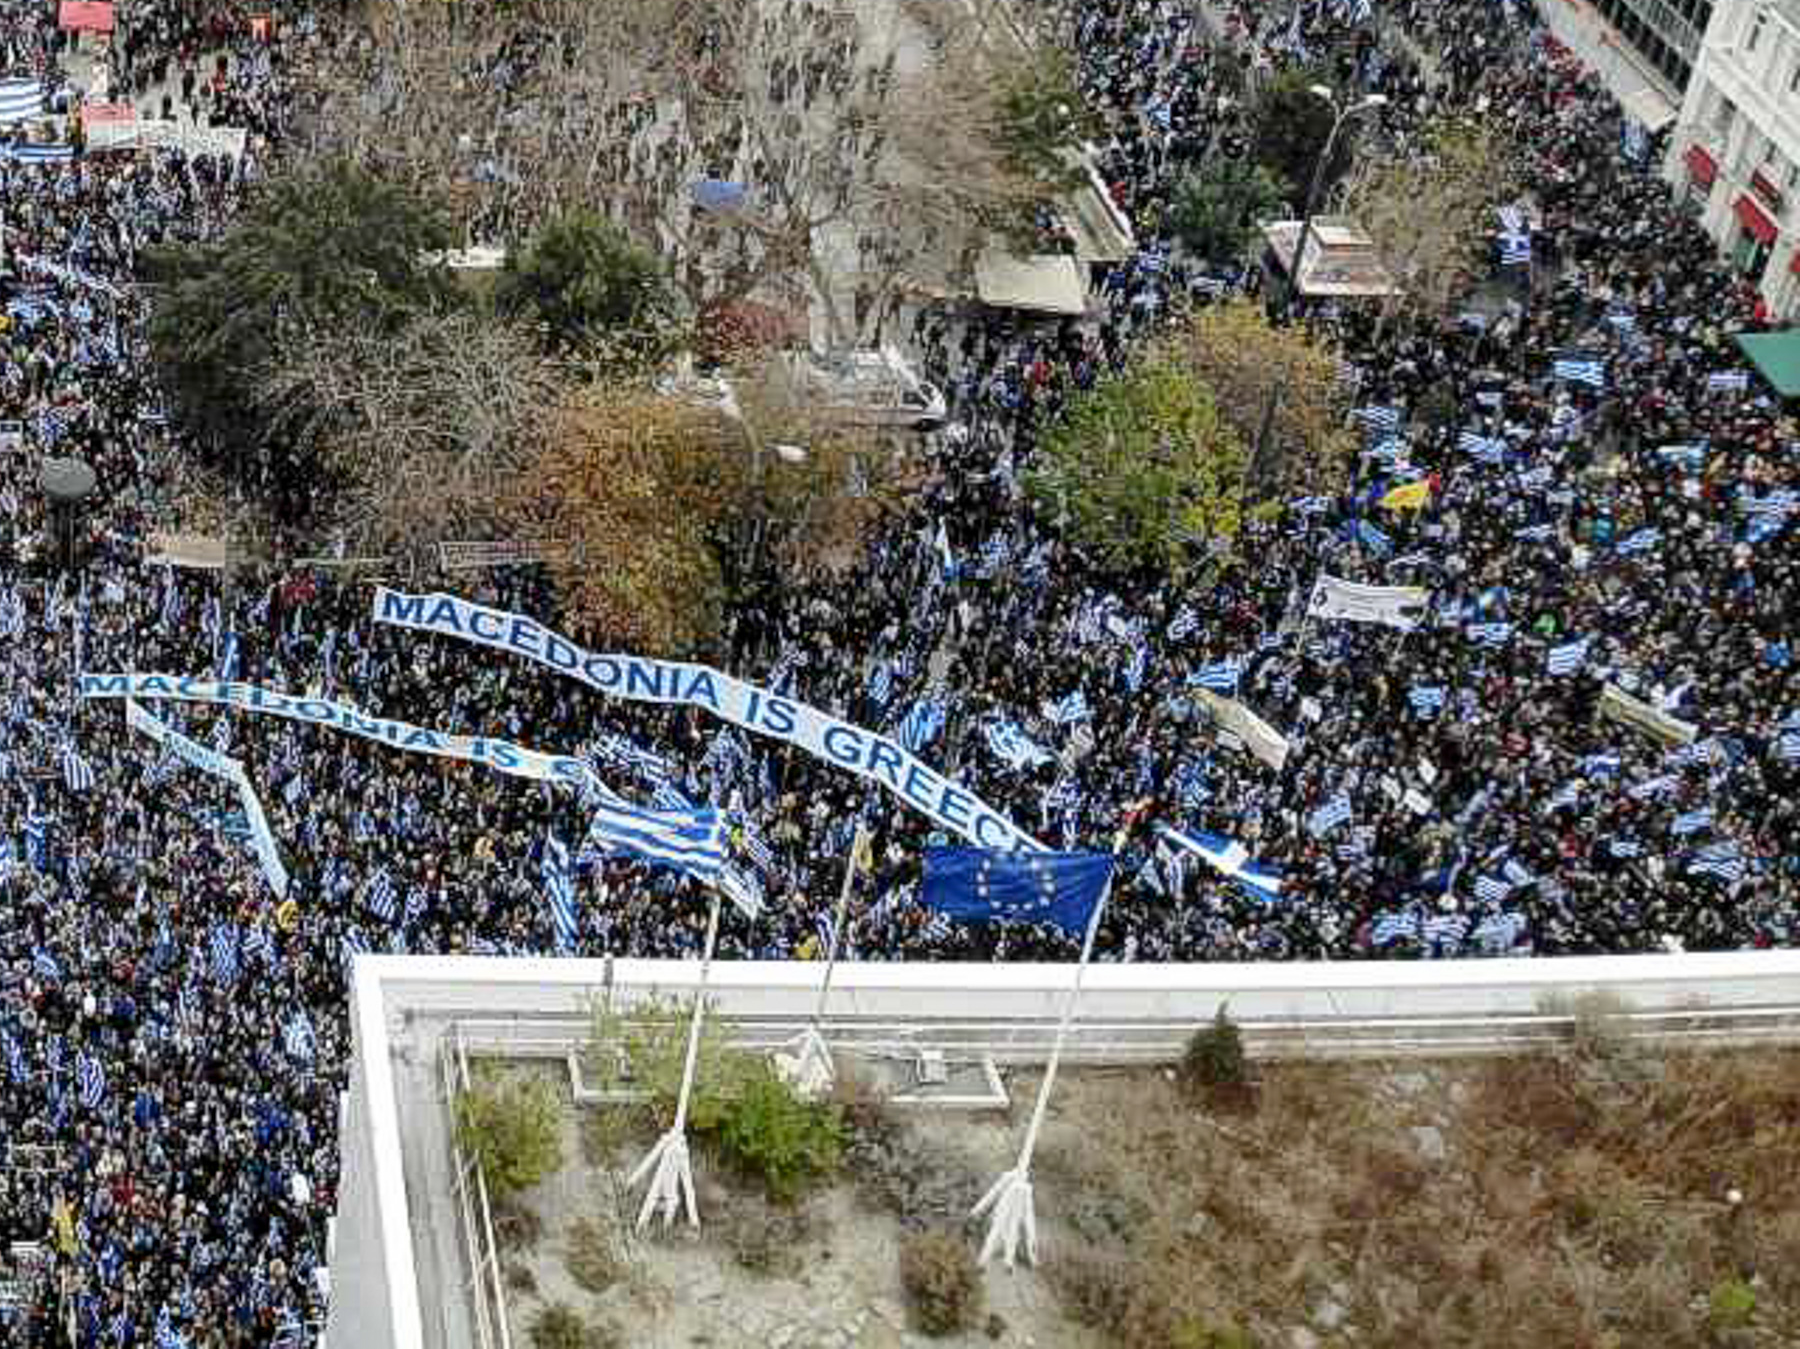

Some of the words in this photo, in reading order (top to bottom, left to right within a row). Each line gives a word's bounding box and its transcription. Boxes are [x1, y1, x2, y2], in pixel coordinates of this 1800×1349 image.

[383, 592, 720, 709] MACEDONIA
[747, 690, 797, 734] IS
[472, 741, 520, 768] IS
